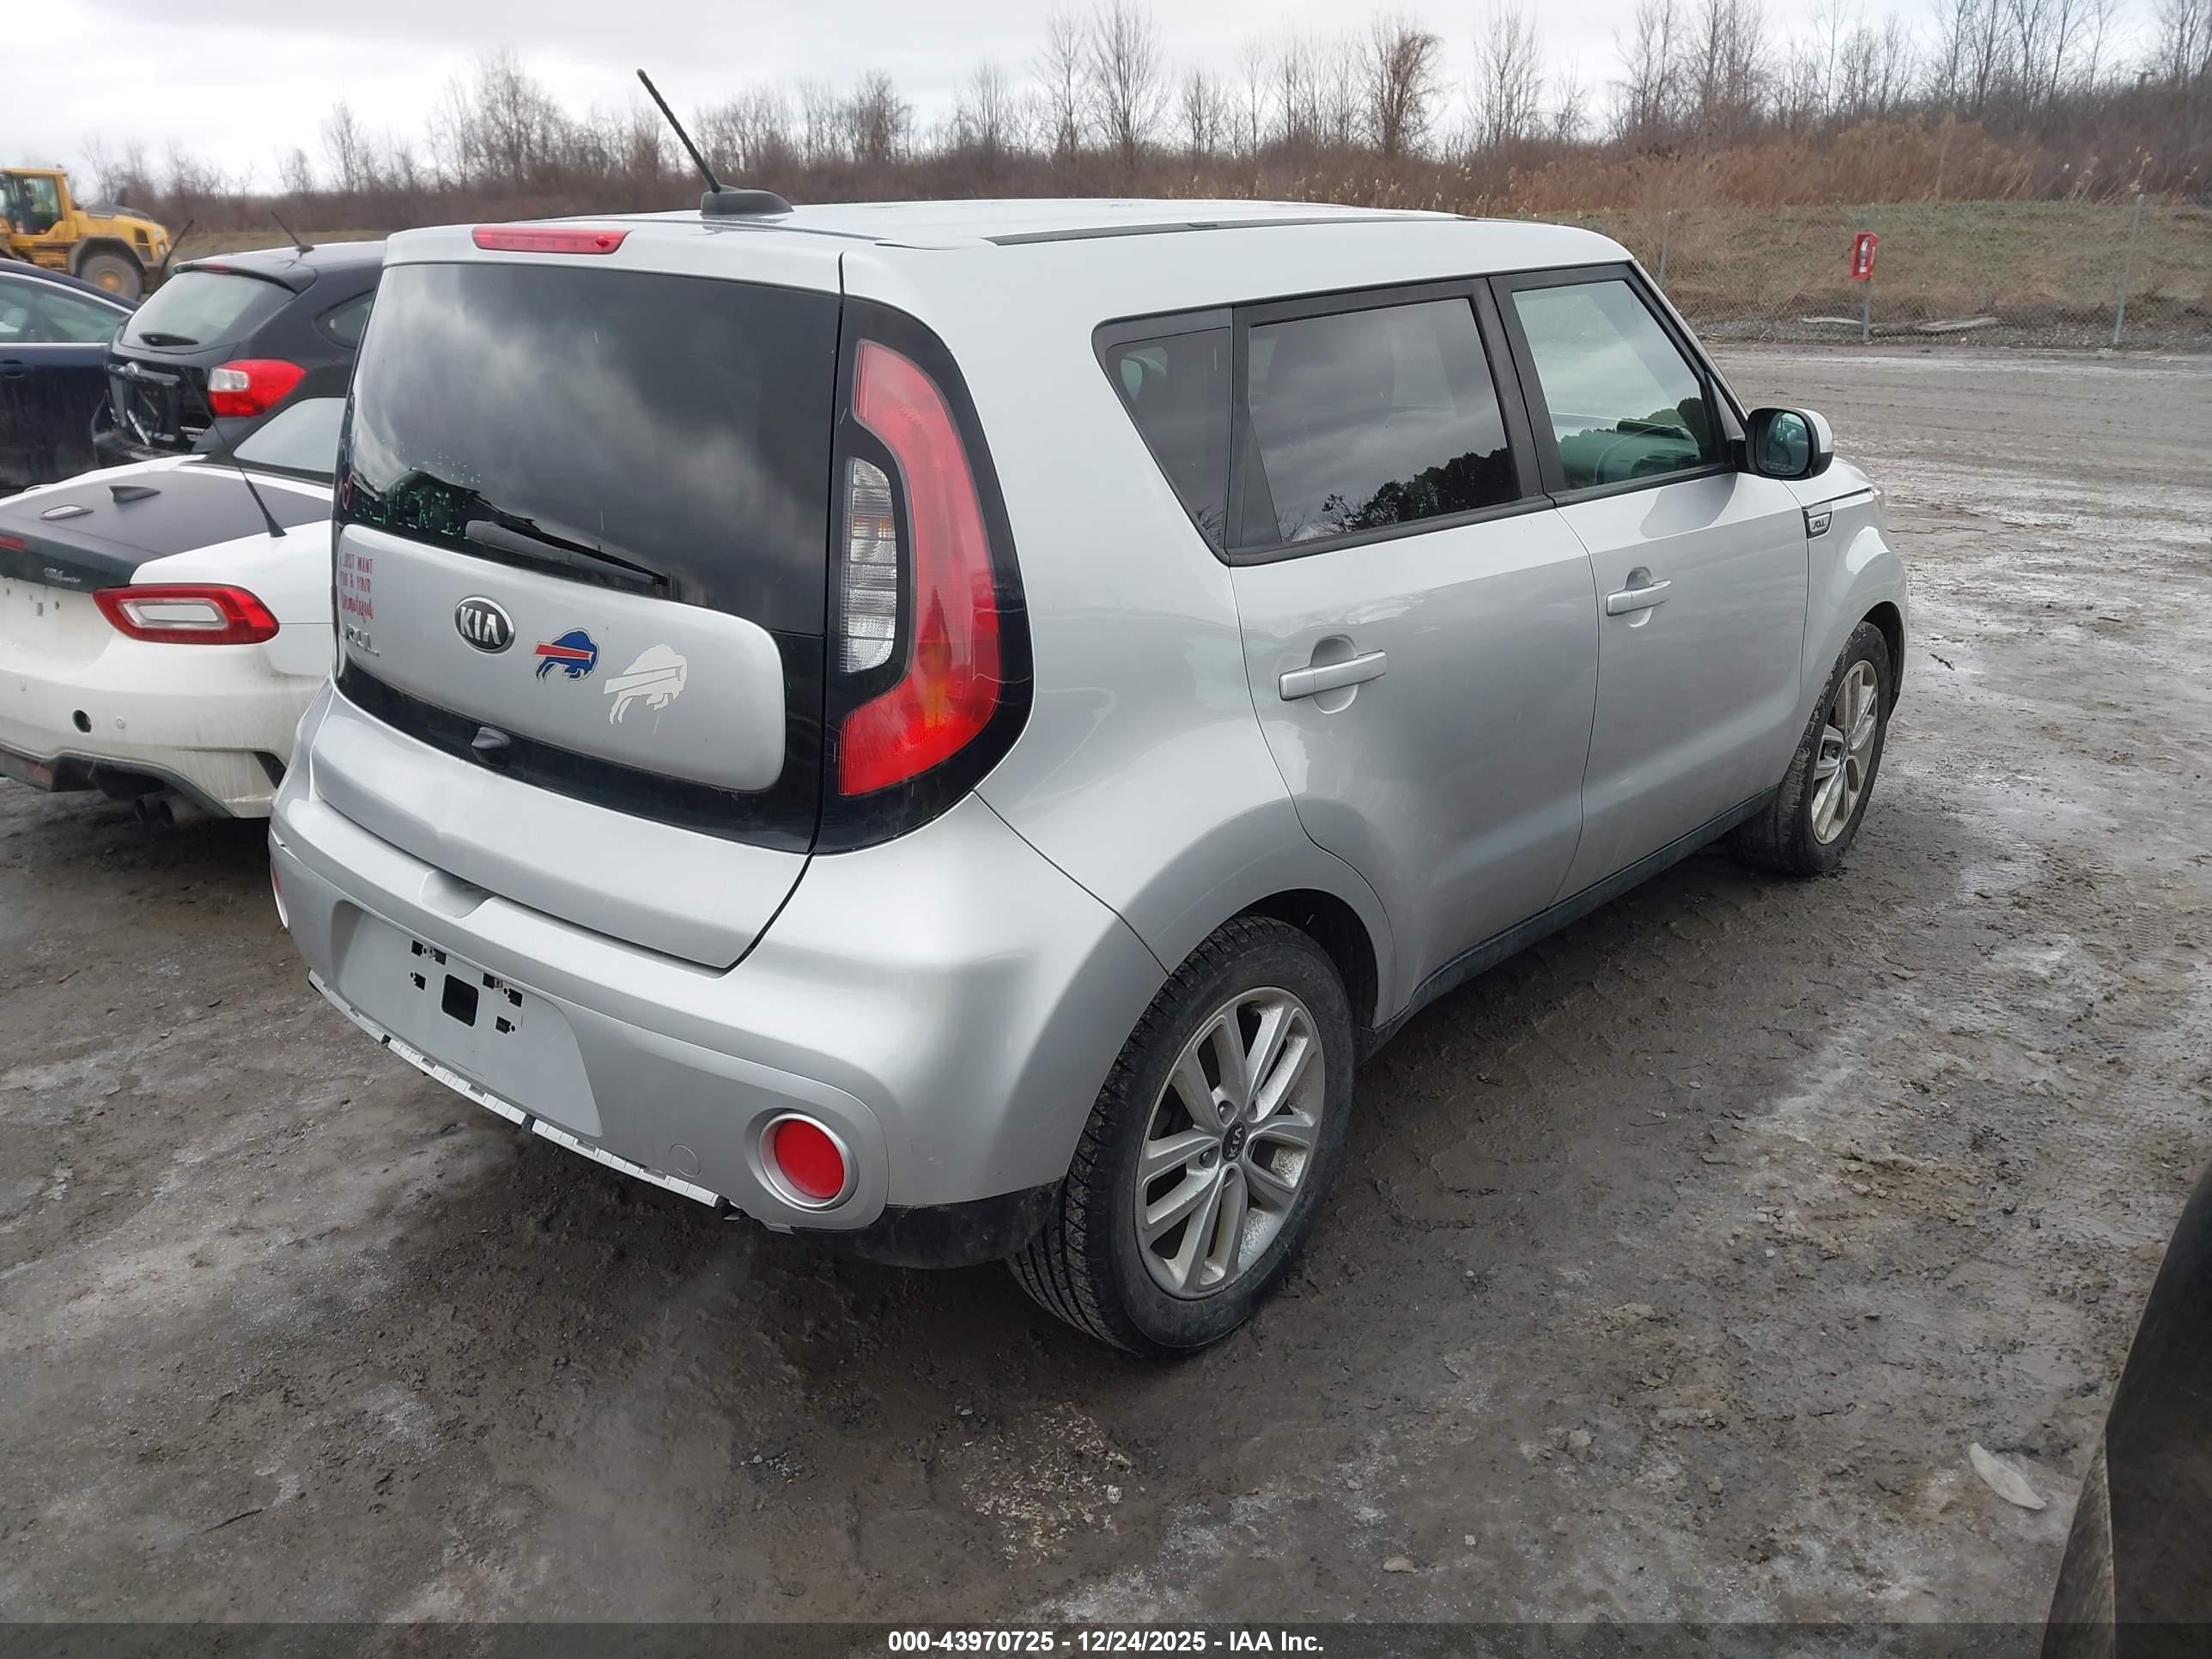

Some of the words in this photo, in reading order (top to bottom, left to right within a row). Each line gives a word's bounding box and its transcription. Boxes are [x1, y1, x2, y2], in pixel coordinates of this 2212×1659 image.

[357, 556, 373, 574] WANT
[459, 606, 501, 645] KIA
[1228, 1127, 1243, 1158] KIA
